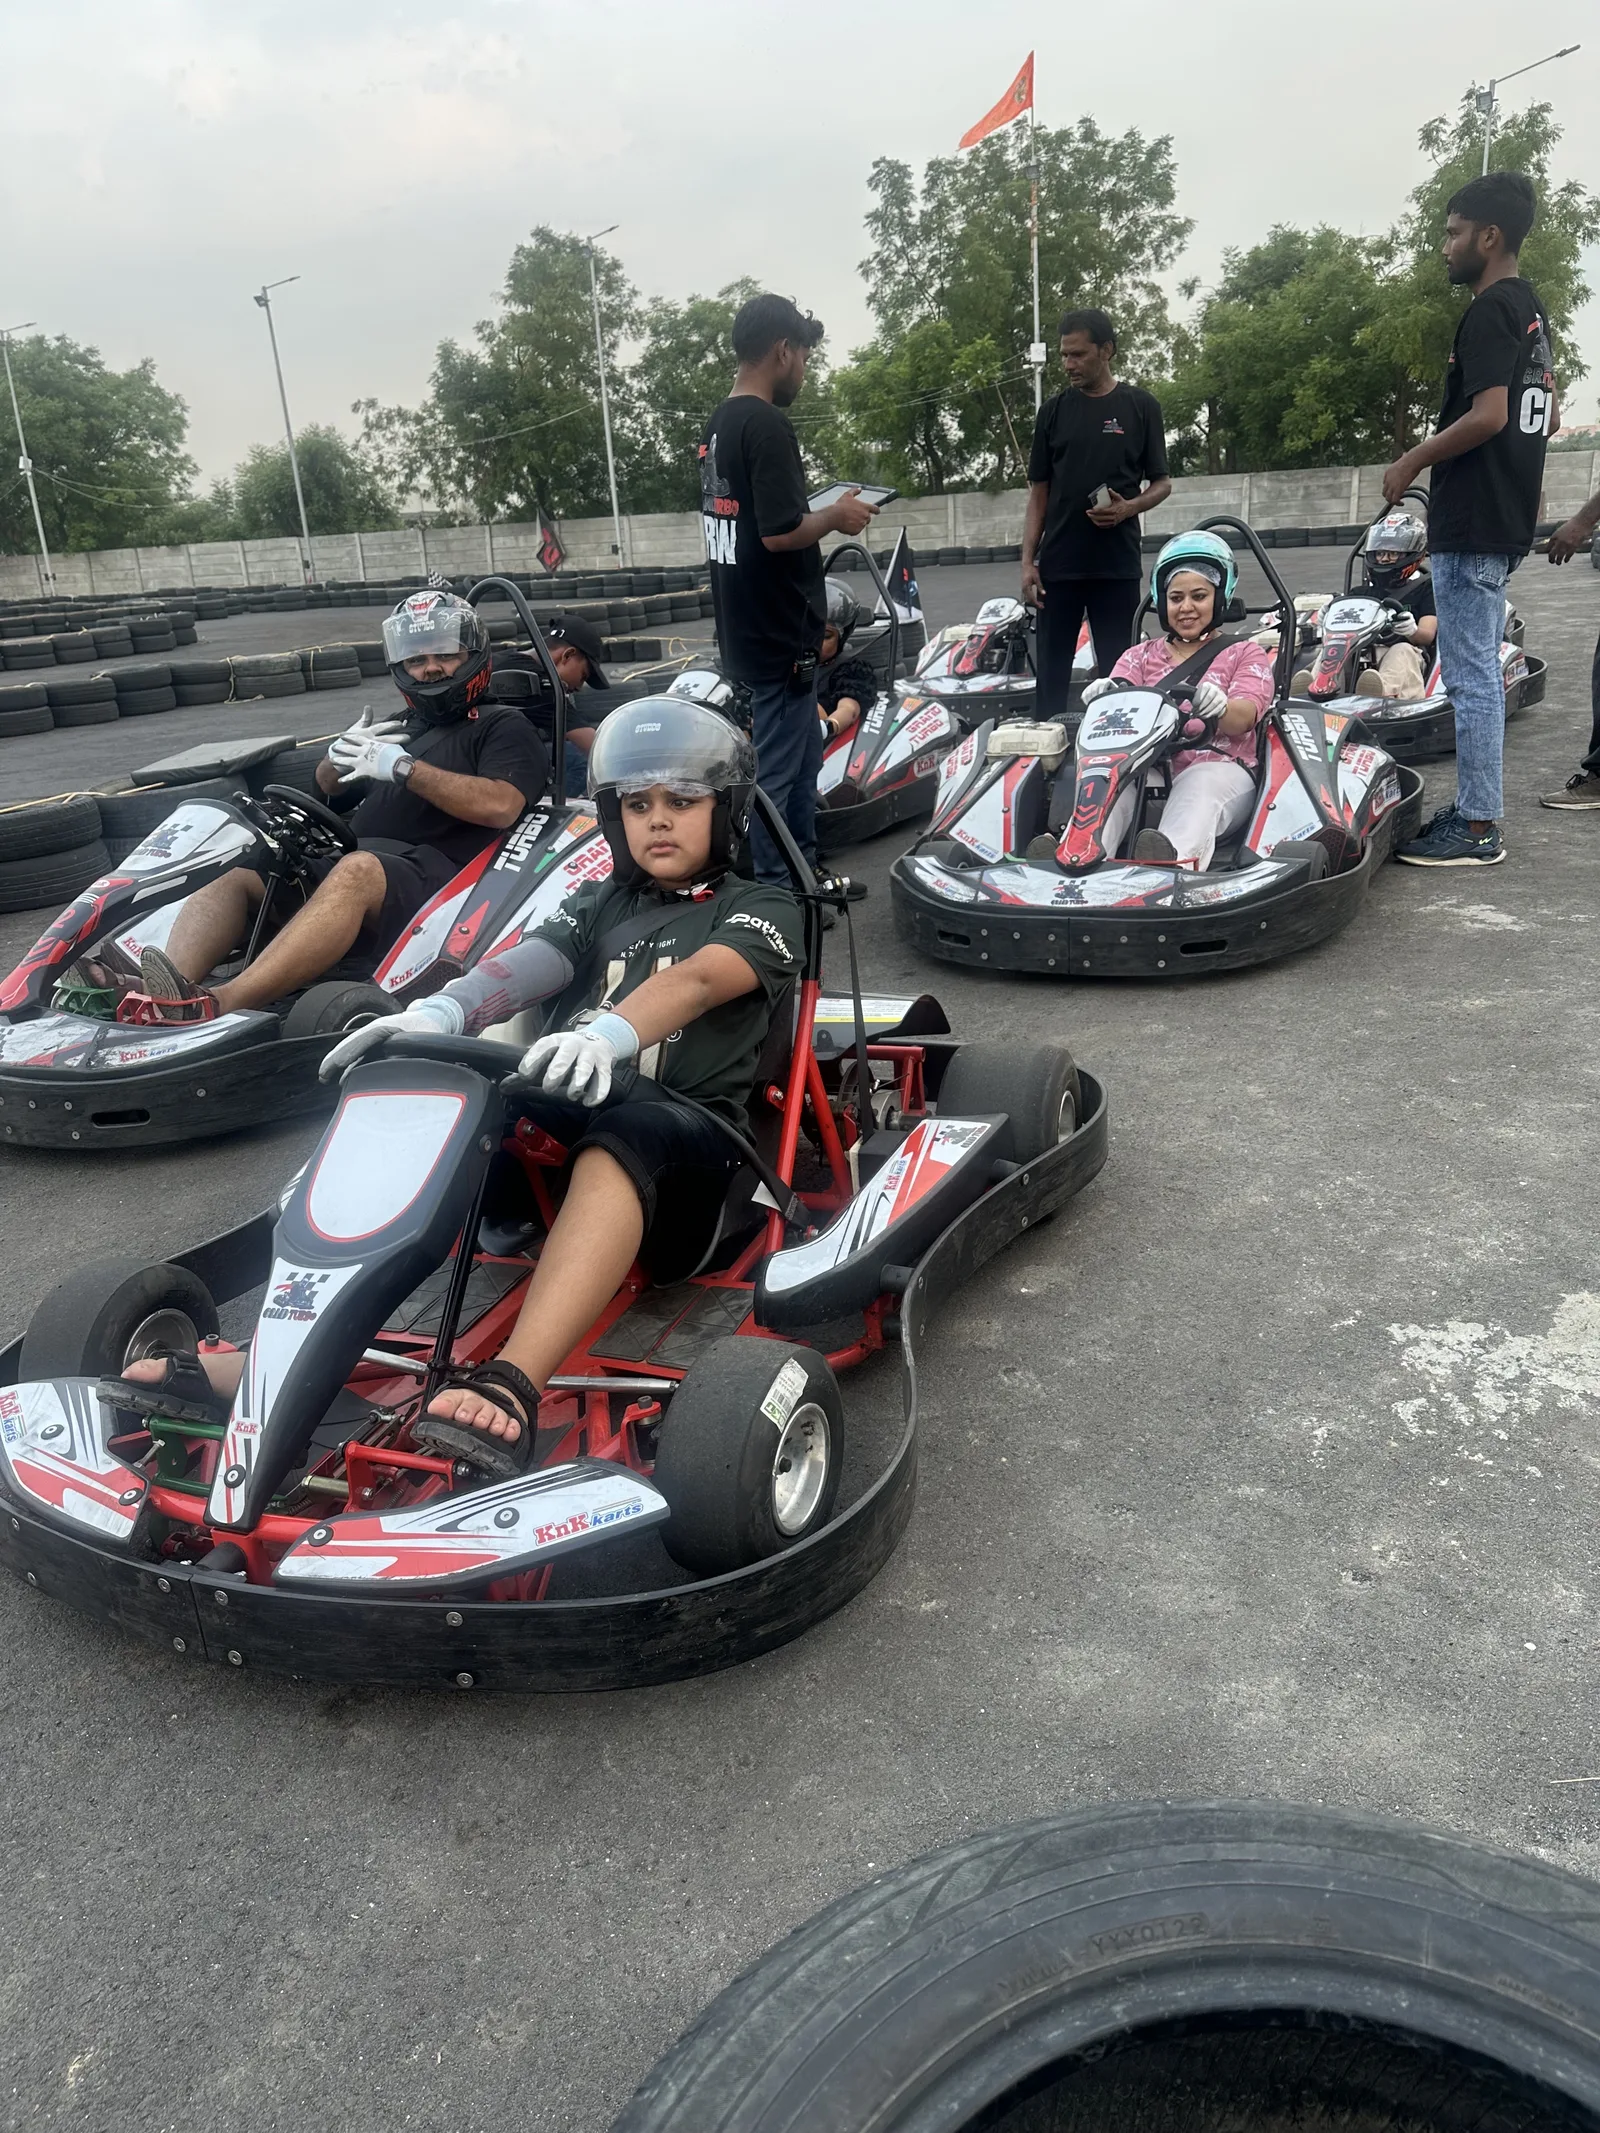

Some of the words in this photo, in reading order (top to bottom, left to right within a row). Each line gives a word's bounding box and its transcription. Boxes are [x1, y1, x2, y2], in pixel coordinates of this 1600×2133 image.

[1327, 647, 1338, 658] 6
[905, 705, 942, 733] GRAND
[909, 719, 944, 745] TURBO
[1281, 713, 1322, 762] TURBO
[917, 754, 936, 773] KnK
[1083, 781, 1096, 798] 1
[493, 813, 550, 873] TURBO
[52, 909, 76, 929] 2
[389, 967, 414, 988] KnK
[118, 1049, 148, 1063] KnK
[4, 1417, 17, 1441] karts
[234, 1421, 258, 1434] KnK
[535, 1513, 590, 1545] KnK
[591, 1503, 643, 1526] karts
